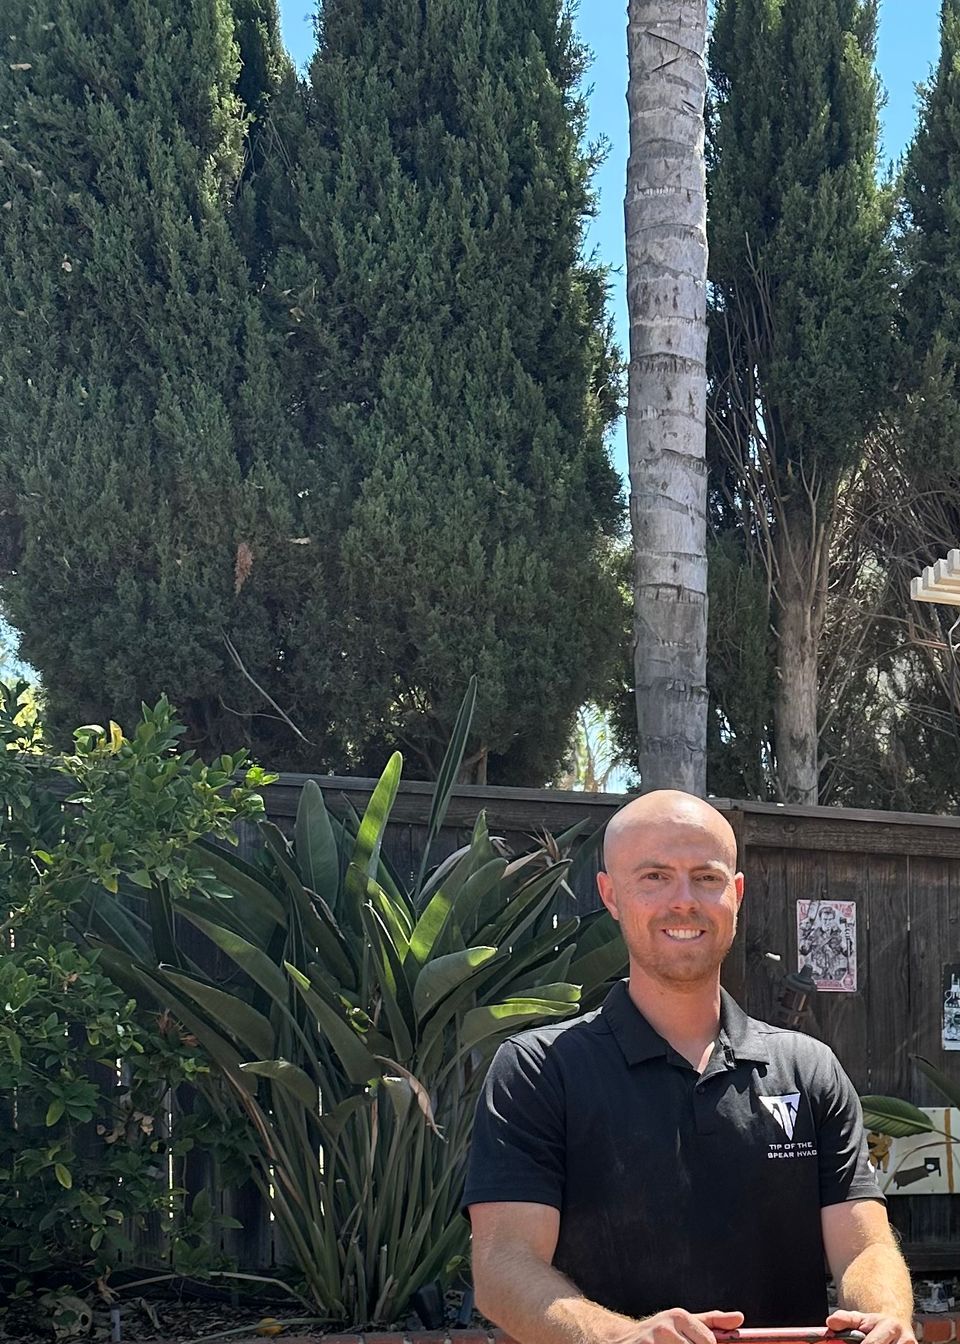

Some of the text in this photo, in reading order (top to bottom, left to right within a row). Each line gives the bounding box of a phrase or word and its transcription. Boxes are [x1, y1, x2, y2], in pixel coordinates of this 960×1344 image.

[797, 1141, 813, 1149] THE
[767, 1149, 818, 1159] SPEAR HVAC
